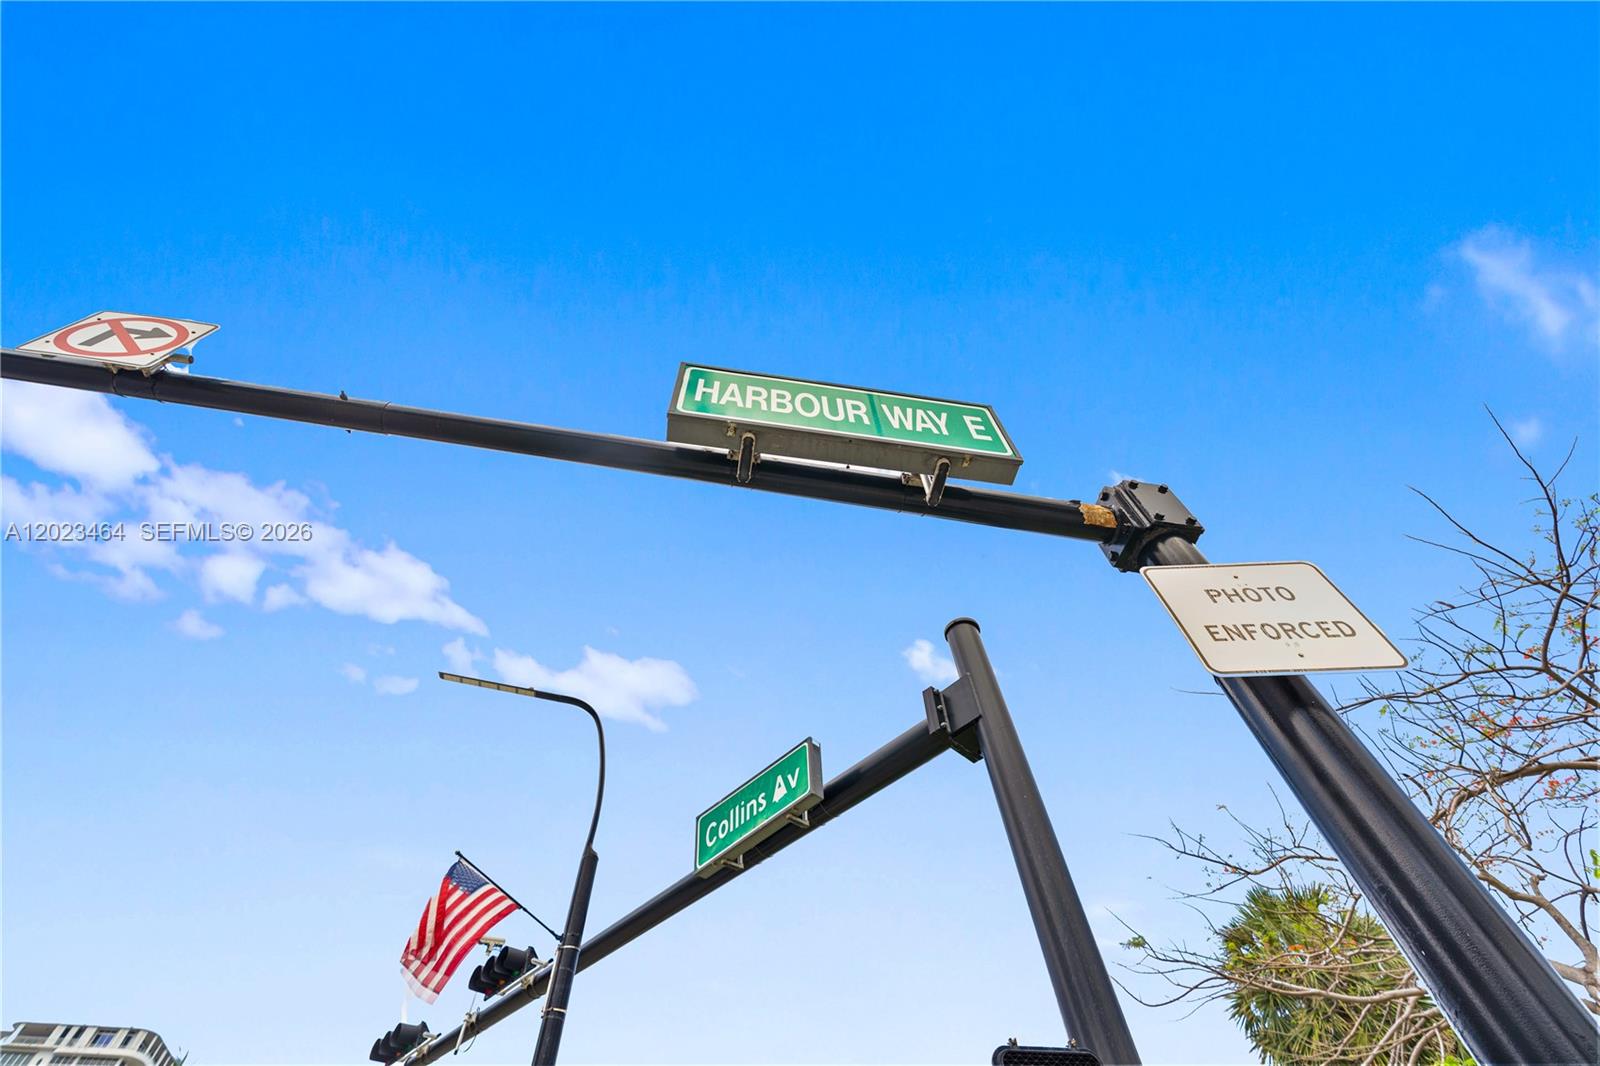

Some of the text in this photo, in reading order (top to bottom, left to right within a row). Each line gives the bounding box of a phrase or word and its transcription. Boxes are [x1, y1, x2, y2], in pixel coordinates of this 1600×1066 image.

[694, 378, 993, 441] HARBOUR WAY E
[1204, 585, 1296, 604] PHOTO
[1204, 620, 1357, 642] ENFORCED
[705, 767, 800, 847] Collins Av
